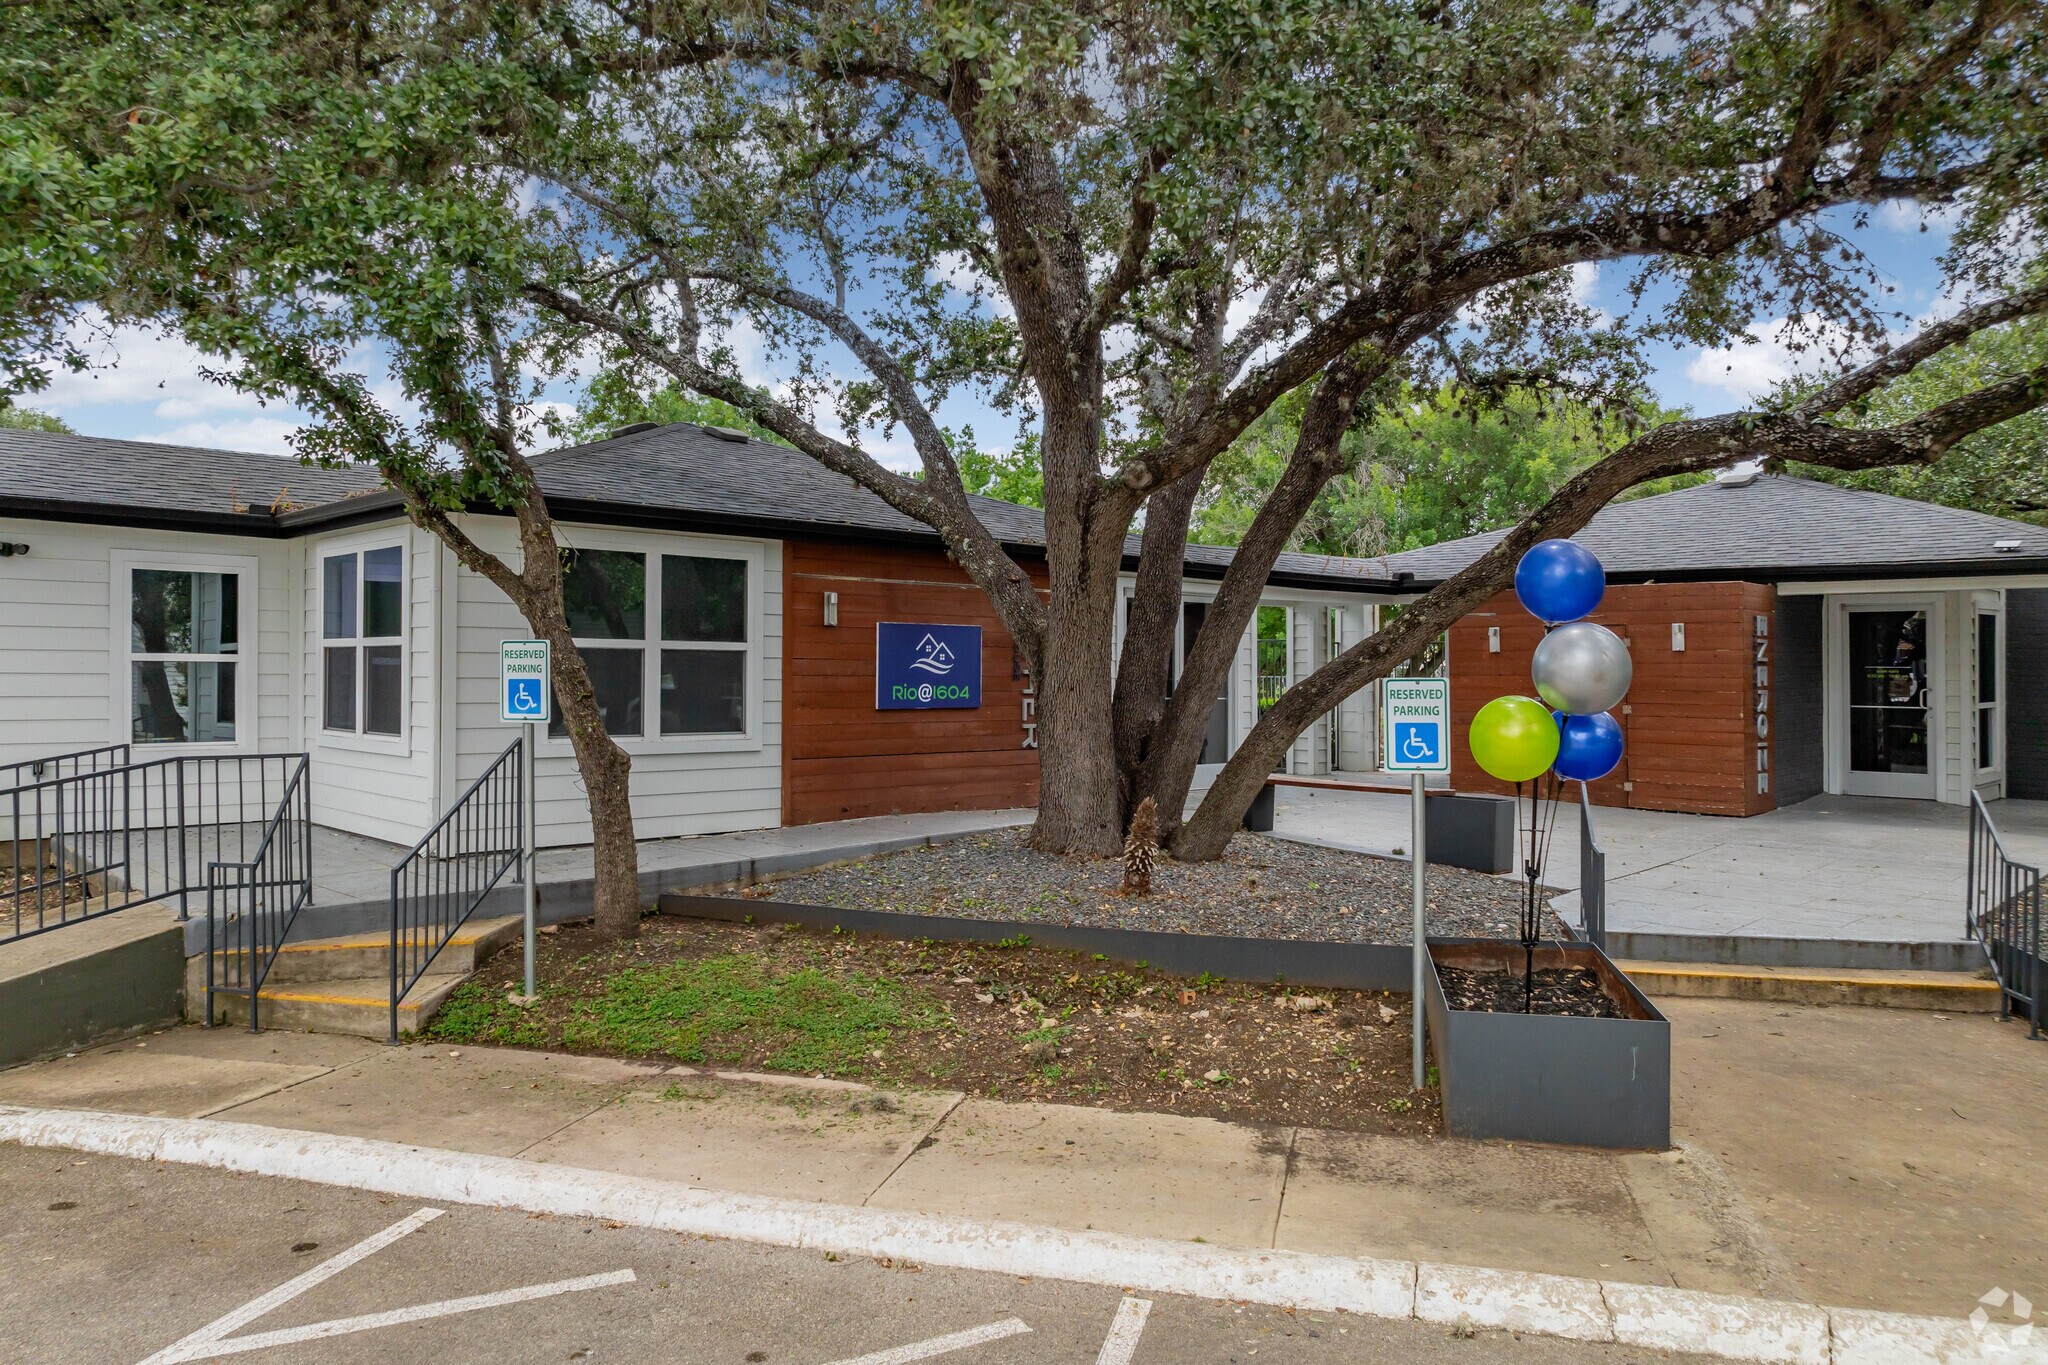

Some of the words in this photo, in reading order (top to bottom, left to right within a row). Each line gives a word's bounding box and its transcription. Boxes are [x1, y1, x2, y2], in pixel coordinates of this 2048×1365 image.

[504, 649, 545, 659] RESERVED
[507, 664, 543, 673] PARKING
[892, 683, 970, 702] Rio@1604
[1389, 689, 1443, 700] RESERVED
[1393, 705, 1440, 716] PARKING
[1756, 615, 1769, 795] ENERGIZE
